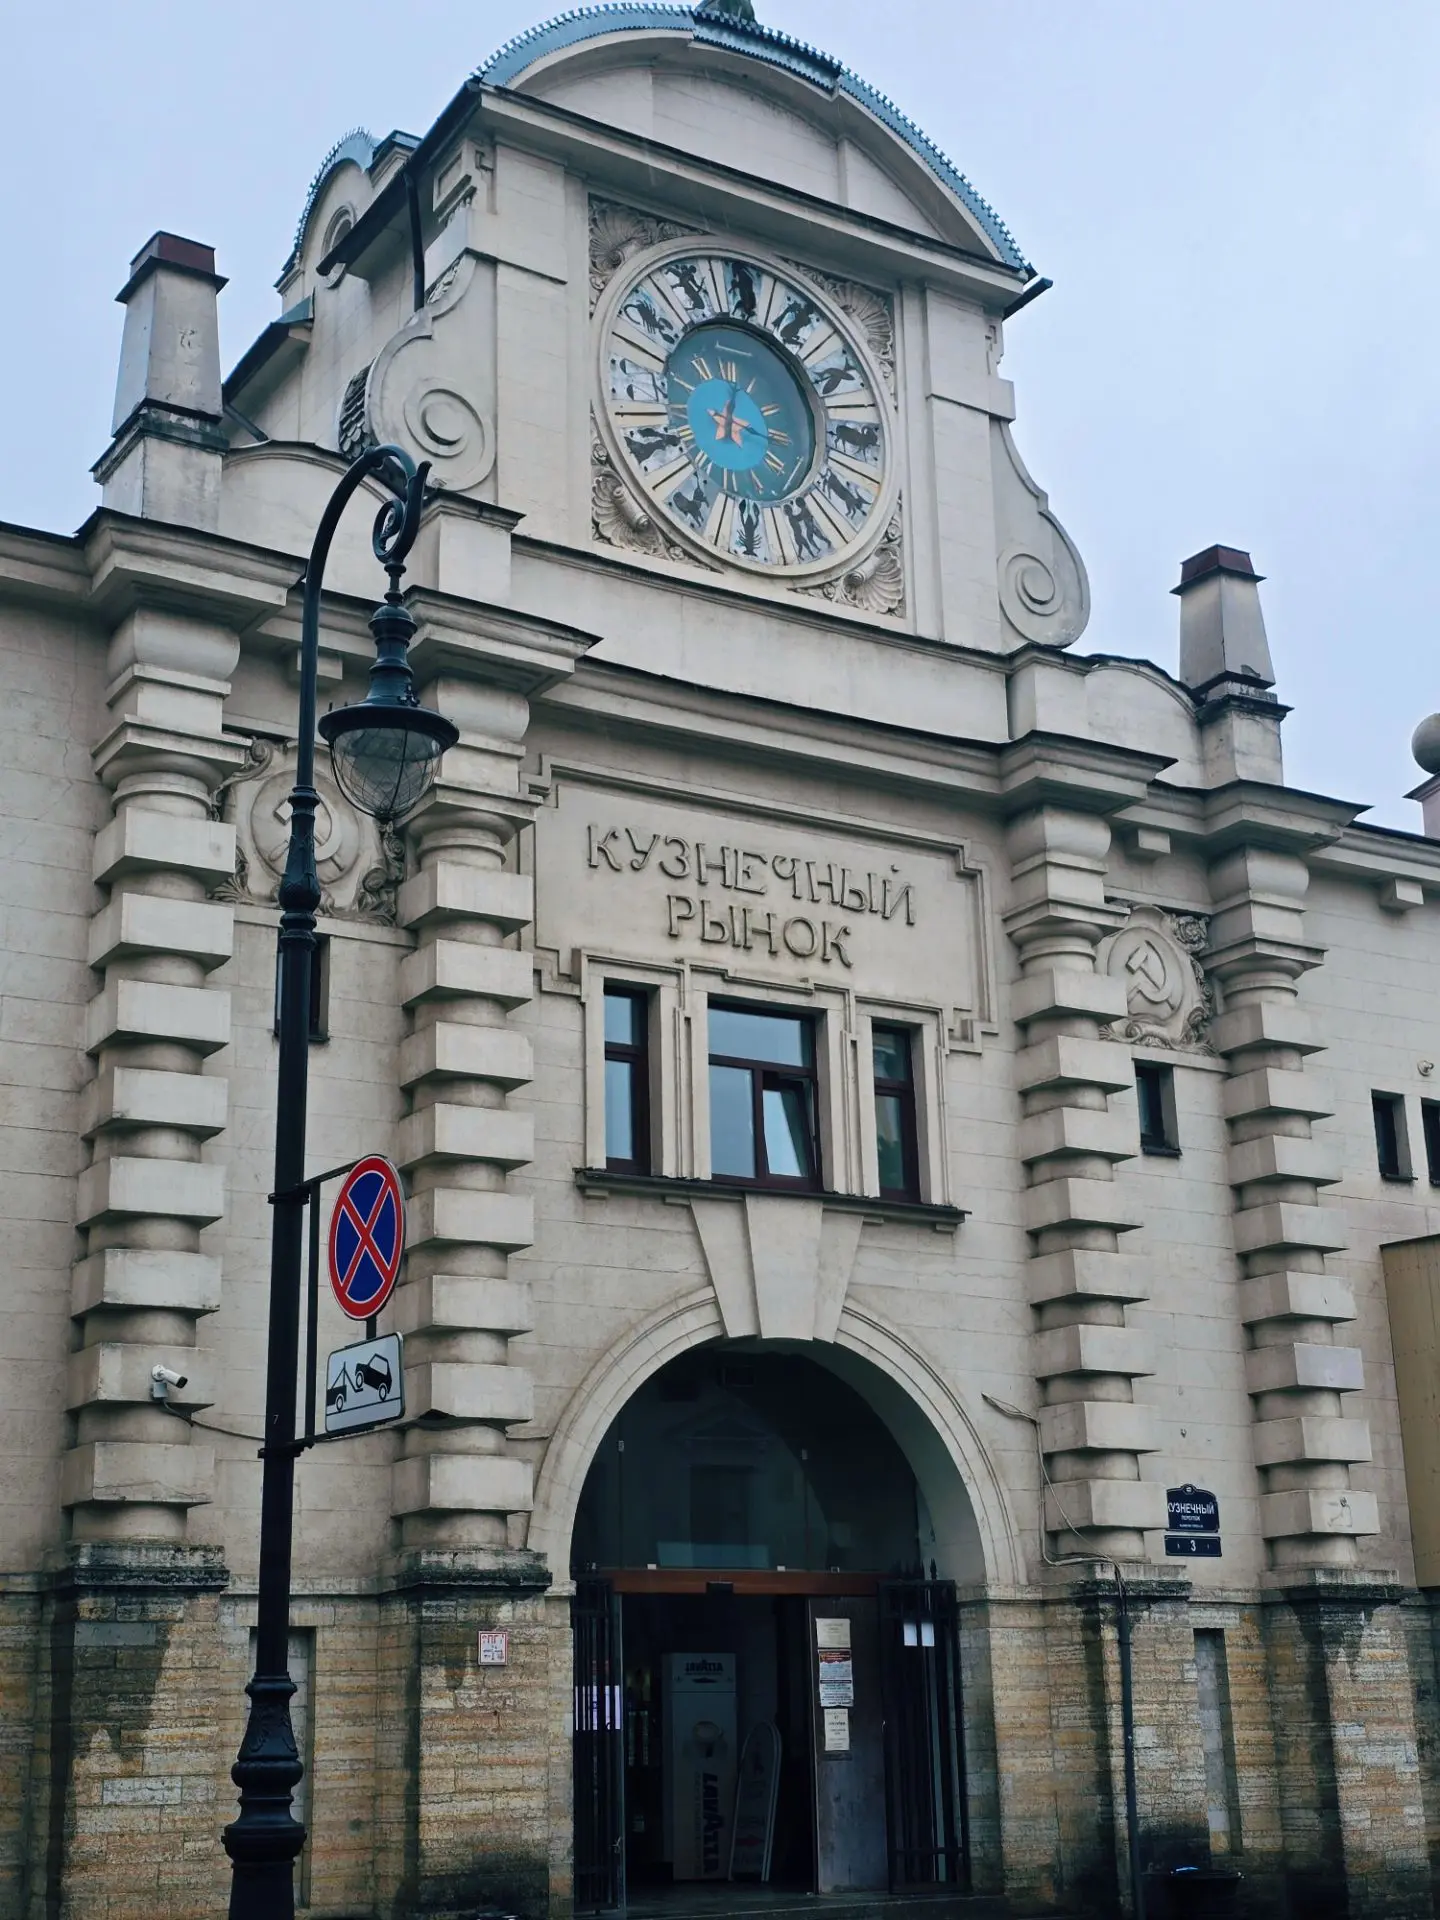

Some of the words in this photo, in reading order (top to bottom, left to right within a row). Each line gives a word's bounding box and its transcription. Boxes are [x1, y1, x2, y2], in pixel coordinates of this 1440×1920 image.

[586, 824, 915, 925] КУЗНЕЧНЫЙ
[666, 894, 853, 968] РЫНОК
[1190, 1540, 1197, 1552] 3
